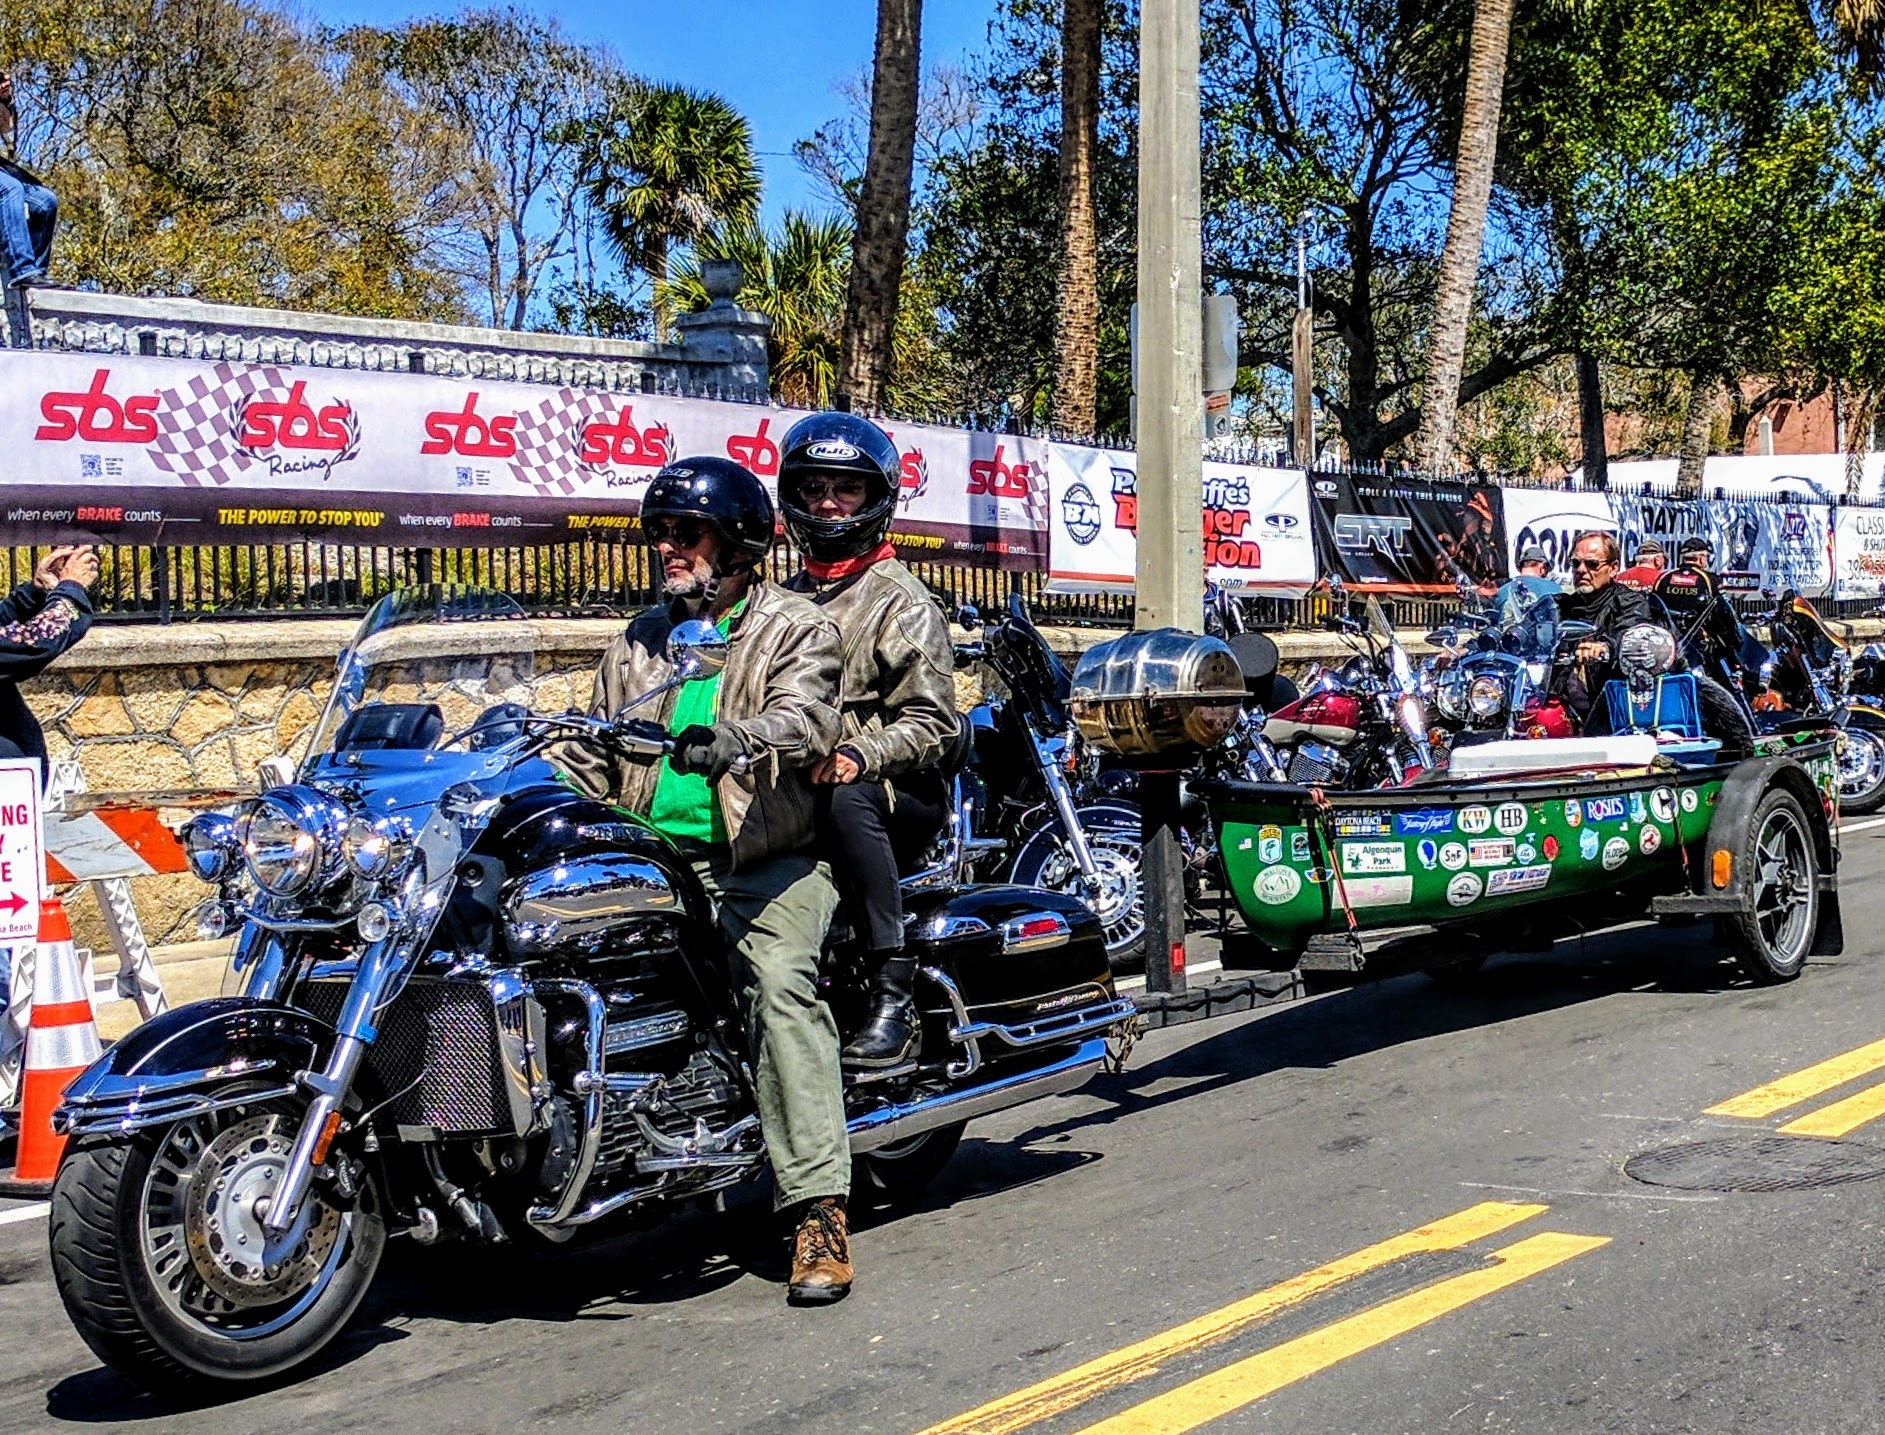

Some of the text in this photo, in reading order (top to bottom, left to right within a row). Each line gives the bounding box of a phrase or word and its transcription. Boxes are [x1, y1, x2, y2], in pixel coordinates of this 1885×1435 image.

[34, 369, 160, 443] sbs
[240, 380, 349, 450] sbs
[420, 392, 518, 458] sbs
[581, 405, 668, 467] sbs
[814, 446, 851, 457] HJC
[268, 454, 332, 480] Racing
[966, 445, 1029, 499] sbs
[8, 506, 162, 523] when every BRAKE counts
[218, 509, 247, 525] THE
[248, 509, 297, 525] POWER
[299, 510, 318, 525] TO
[318, 511, 352, 526] STOP
[399, 512, 523, 529] when every BRAKE counts
[567, 515, 590, 529] THE
[590, 515, 629, 529] POWER
[1061, 499, 1101, 529] BN
[903, 535, 925, 547] STOP
[953, 540, 970, 551] when
[1666, 586, 1698, 596] LOTUS
[1463, 810, 1487, 828] KW
[1500, 808, 1523, 828] HB
[1362, 844, 1402, 856] Algonquin
[1373, 857, 1392, 865] Park
[9, 923, 33, 932] Beach
